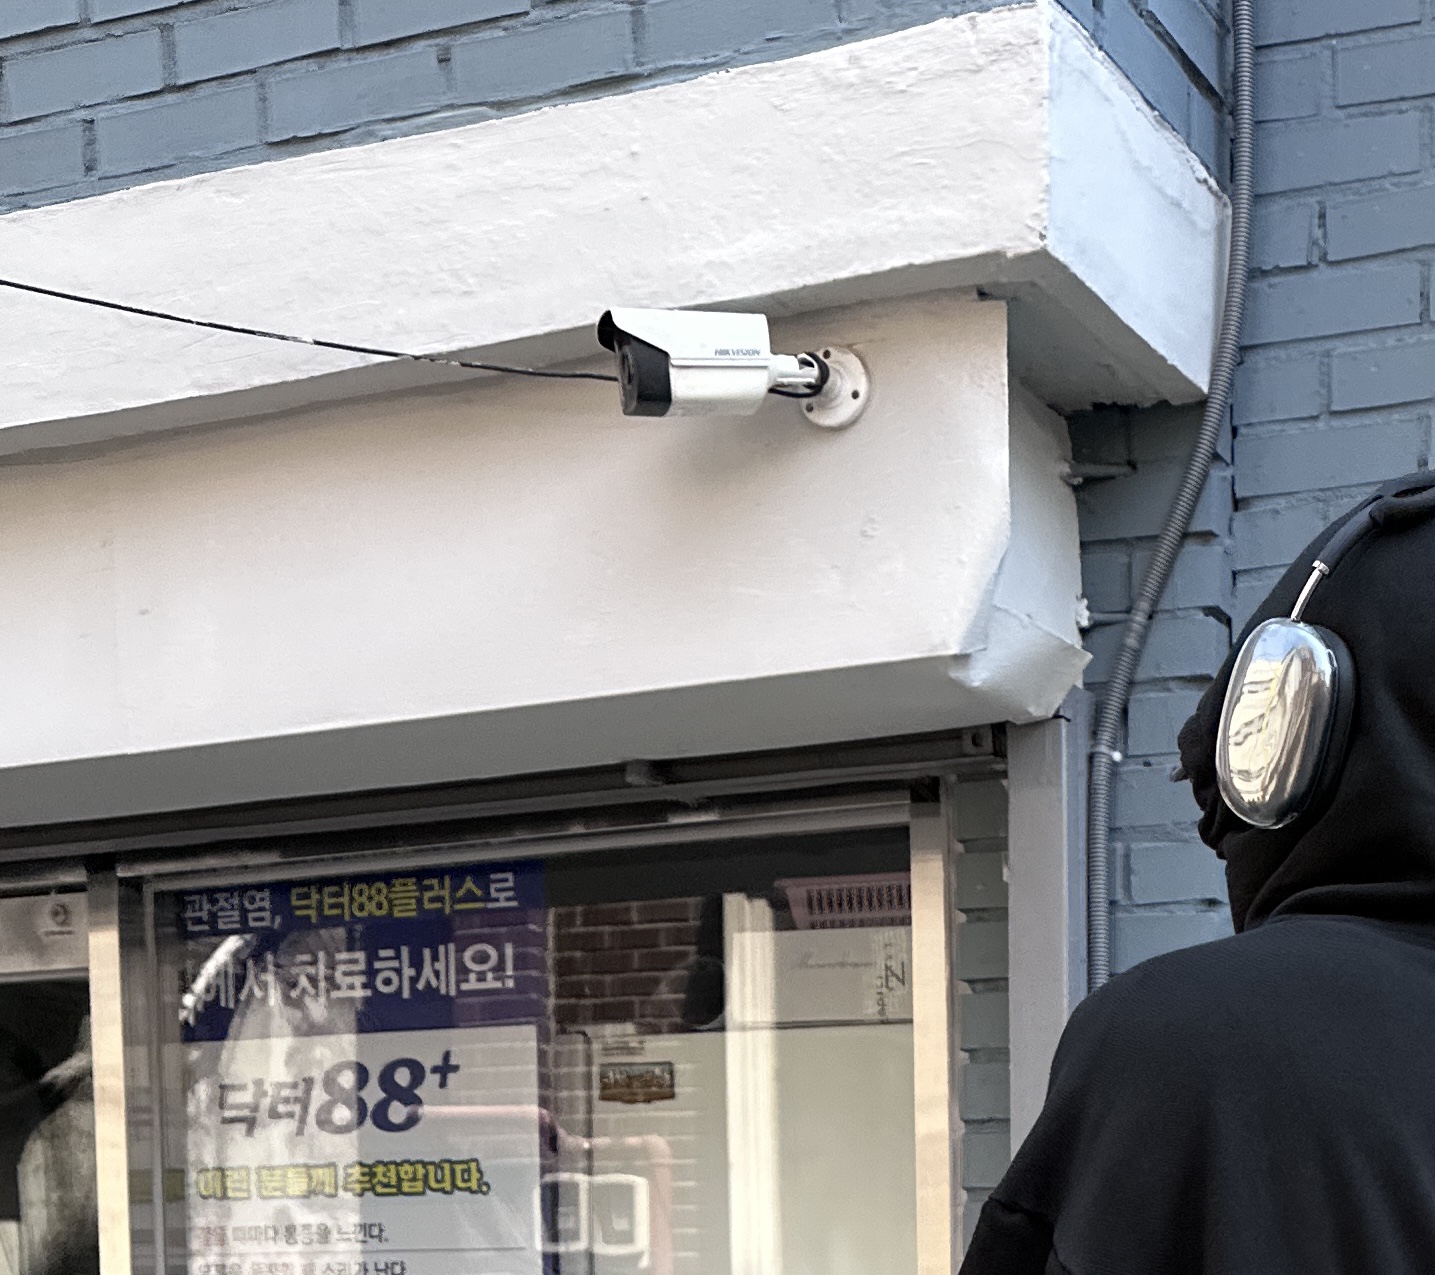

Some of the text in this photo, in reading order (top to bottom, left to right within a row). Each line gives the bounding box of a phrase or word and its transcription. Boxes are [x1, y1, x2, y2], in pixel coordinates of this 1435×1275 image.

[183, 871, 519, 932] 관절염, 닥터88플러스로
[289, 942, 515, 1006] 치료하세요!
[342, 1157, 491, 1197] 추천합니다.
